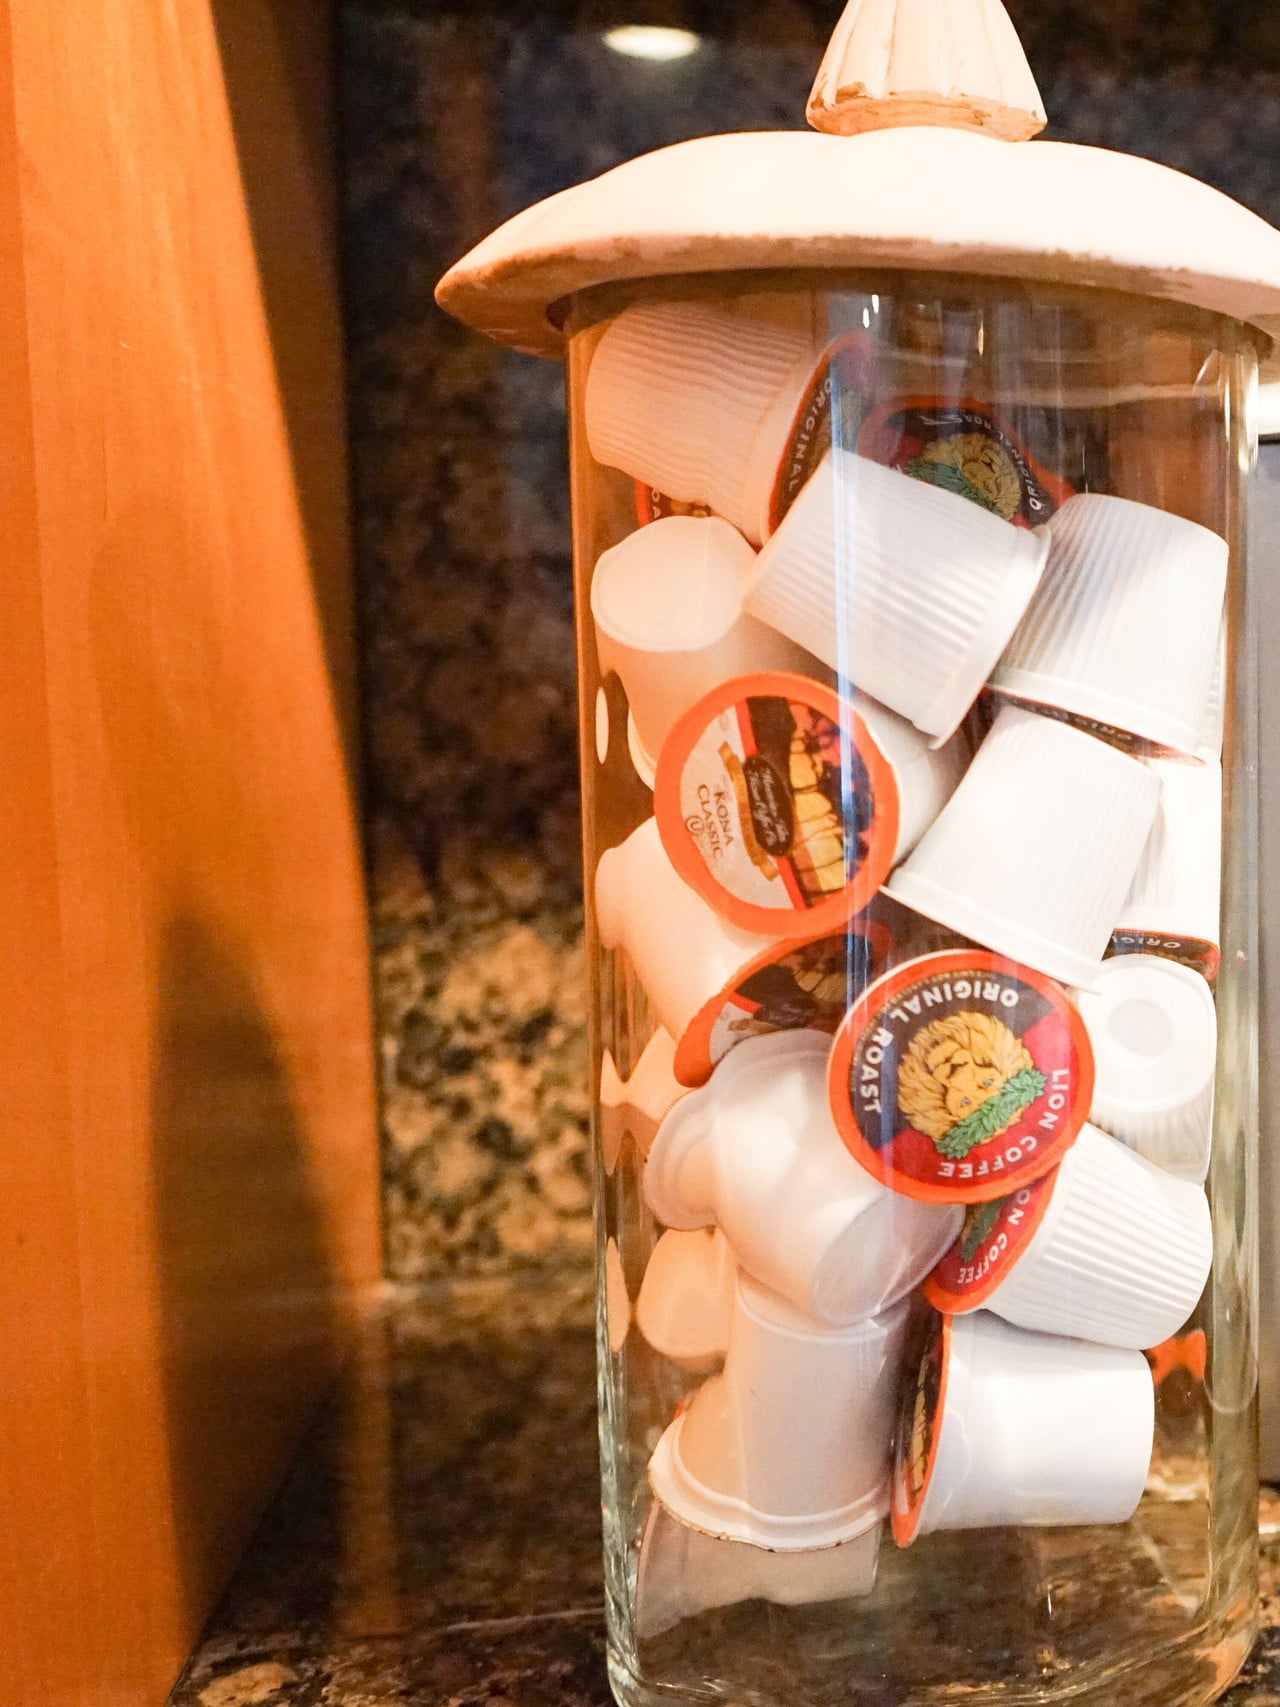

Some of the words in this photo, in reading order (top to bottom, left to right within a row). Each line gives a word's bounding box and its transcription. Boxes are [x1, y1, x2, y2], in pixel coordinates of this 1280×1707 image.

[788, 377, 831, 492] ORIGINAL
[999, 430, 1042, 511] ORIGINAL
[697, 784, 723, 859] CLASSIC
[714, 791, 734, 846] KONA
[1112, 935, 1181, 949] ORIGI
[889, 980, 1019, 1023] ORIGINAL
[860, 1027, 893, 1114] ROAST
[1038, 1068, 1070, 1130] LION
[937, 1136, 1037, 1178] COFFEE
[1007, 1189, 1031, 1226] ON
[957, 1233, 1008, 1284] COFFEE
